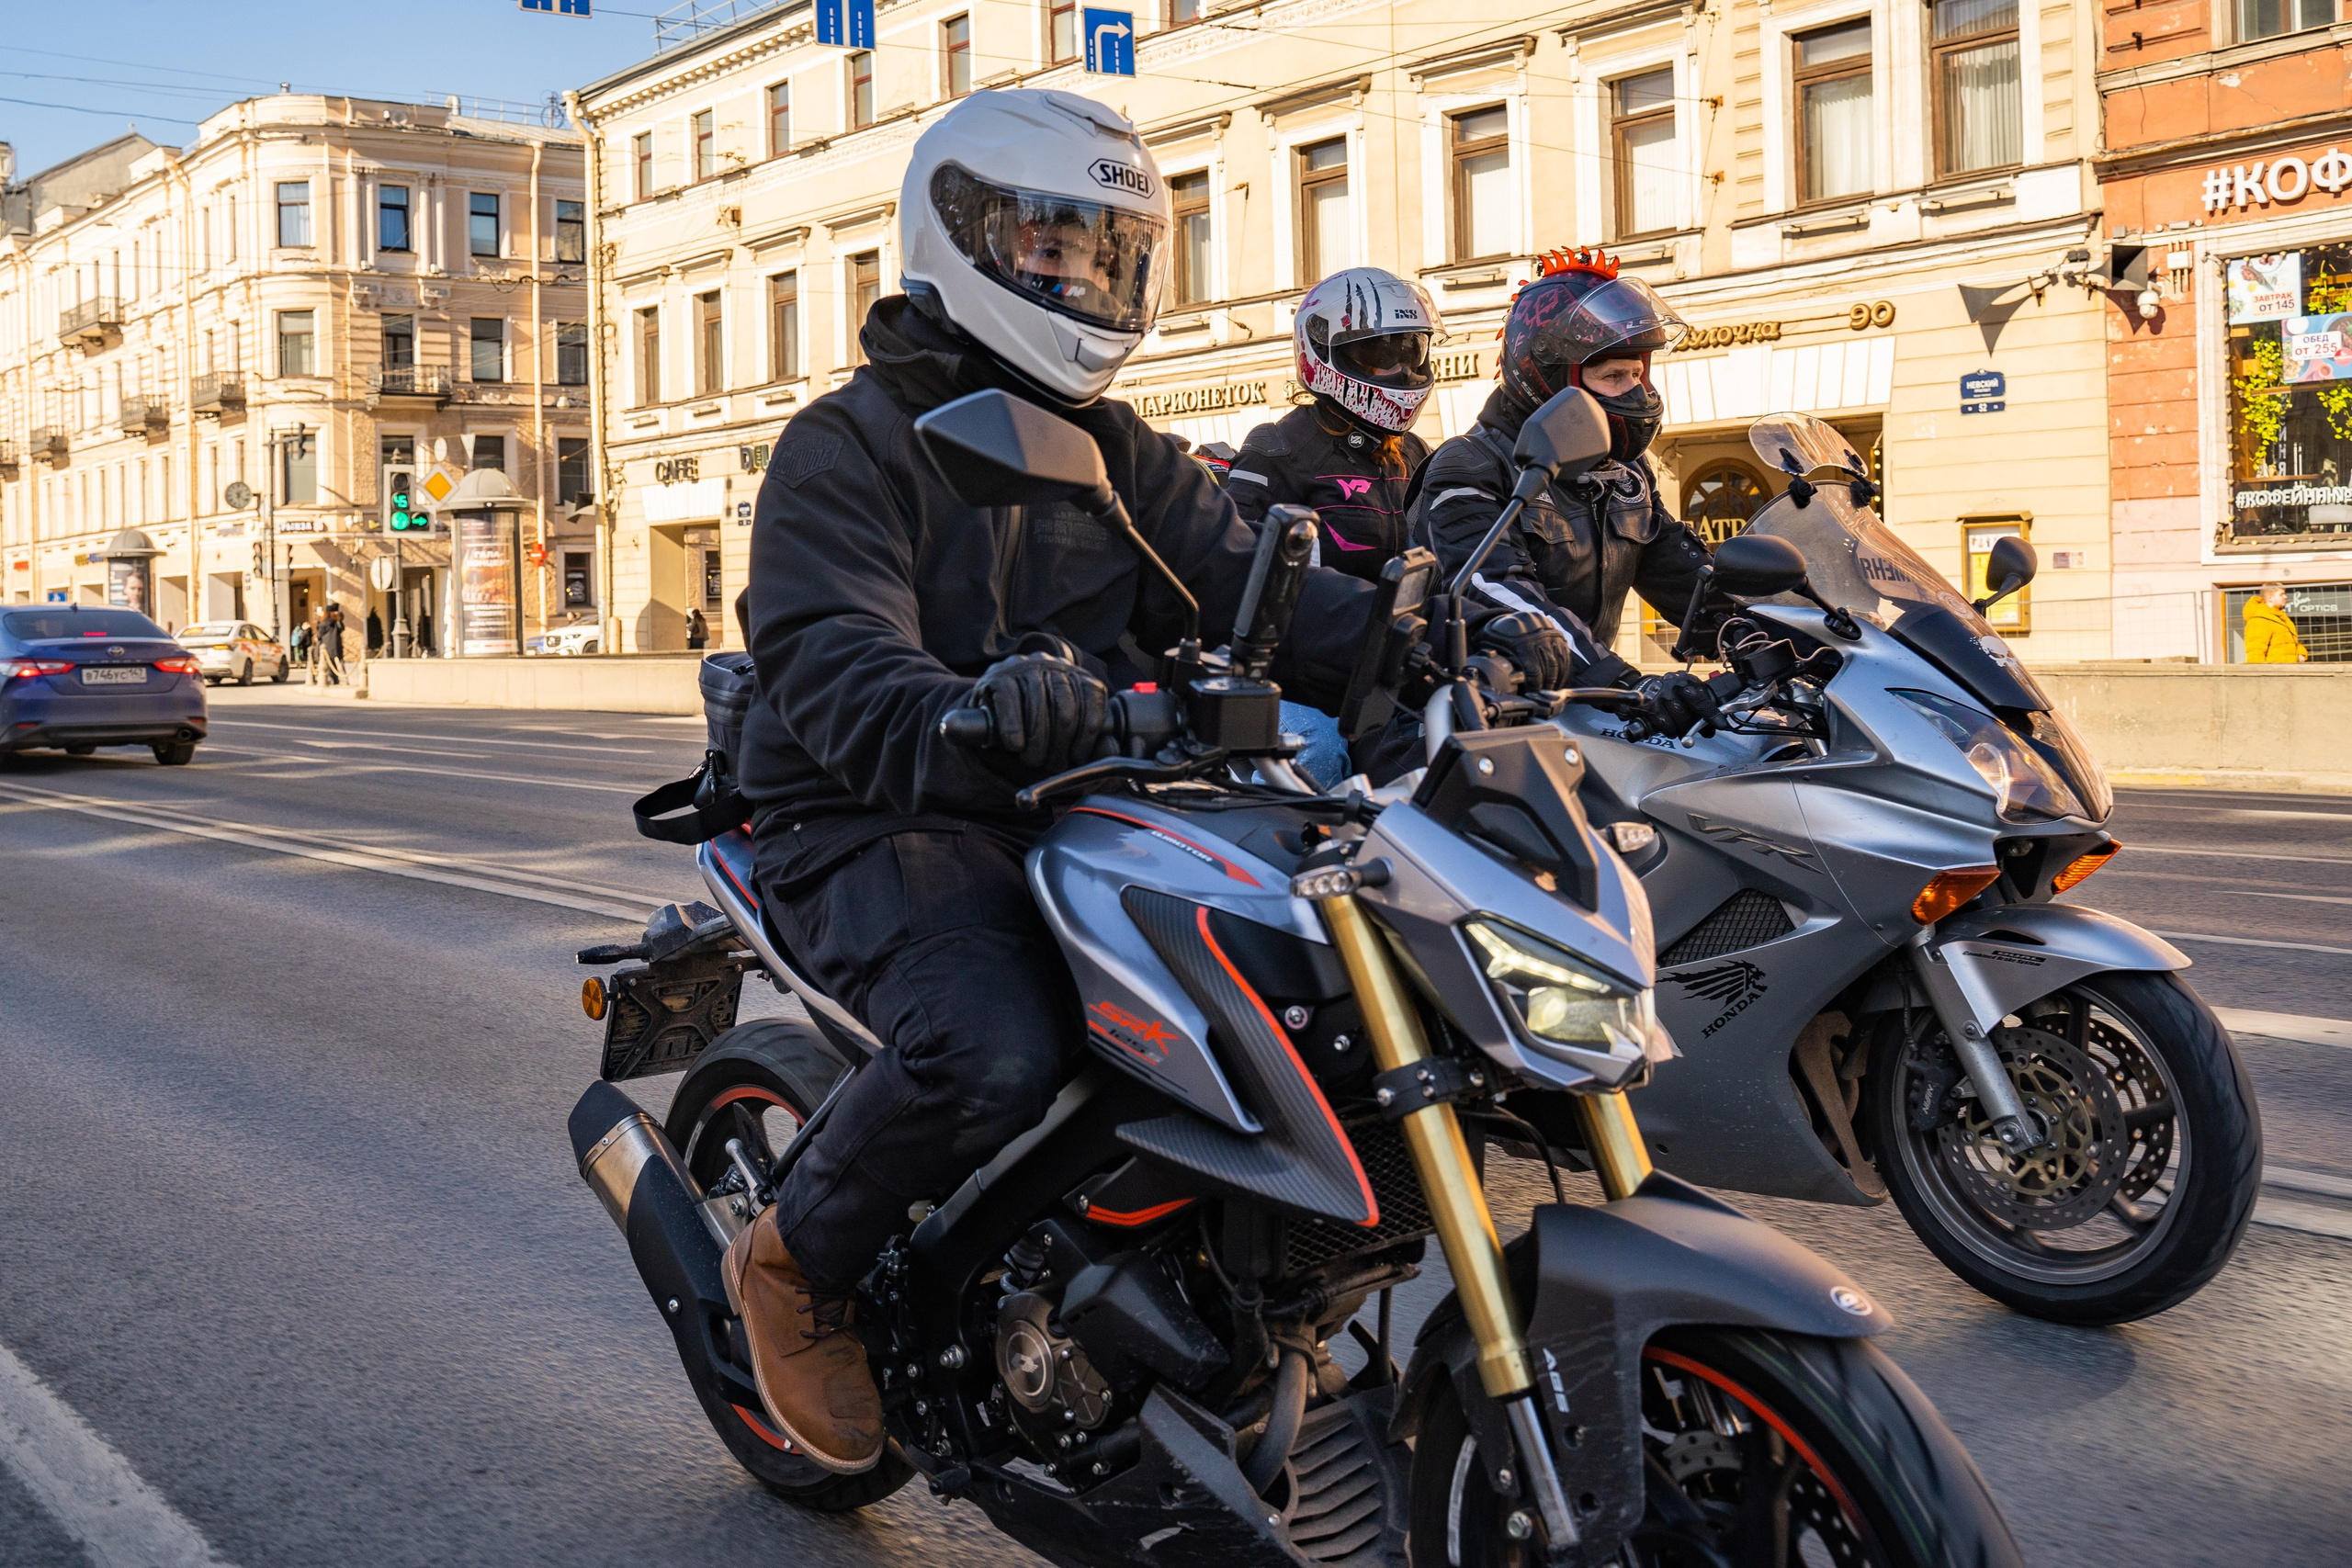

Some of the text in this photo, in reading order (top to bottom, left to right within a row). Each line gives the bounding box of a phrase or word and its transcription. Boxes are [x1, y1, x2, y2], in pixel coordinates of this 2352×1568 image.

[1100, 164, 1148, 194] SHOEI
[2253, 292, 2292, 303] ЗАВТРАК
[2276, 299, 2295, 310] 145
[1849, 300, 1895, 330] 90
[2303, 334, 2329, 344] ОБЕД
[2315, 343, 2337, 355] 255
[1966, 378, 1999, 389] НЕВСКИЙ
[1131, 381, 1265, 416] МАРИОНЕТОК
[1978, 403, 1987, 412] 52
[393, 494, 408, 508] 45
[2300, 604, 2338, 612] OPTICS
[1600, 728, 1677, 750] HODA
[1702, 992, 1761, 1039] HONDA
[1543, 1348, 1570, 1413] ABS
